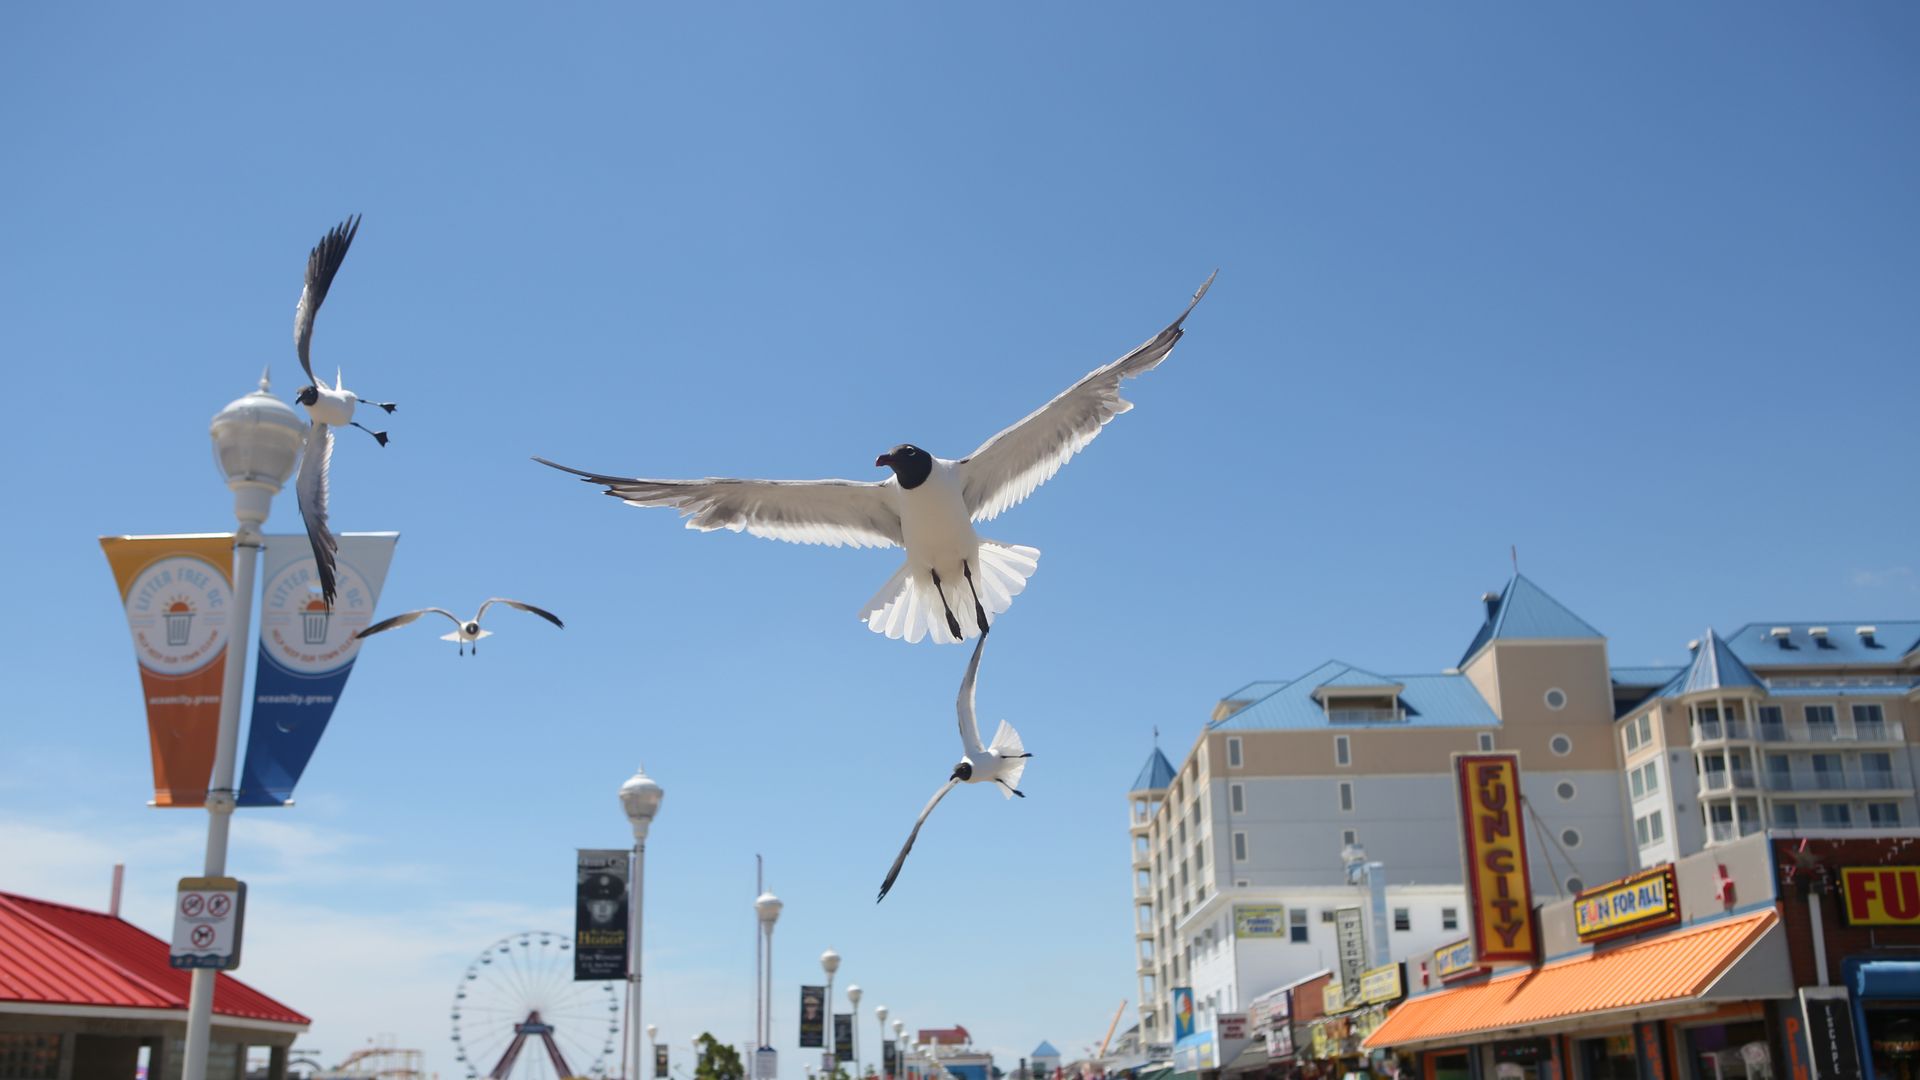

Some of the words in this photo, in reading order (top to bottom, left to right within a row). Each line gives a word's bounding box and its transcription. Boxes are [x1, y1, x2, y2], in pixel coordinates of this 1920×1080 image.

[136, 570, 171, 611] LITTER
[177, 568, 209, 589] FREE
[270, 569, 309, 608] LITTER
[150, 694, 220, 706] oceancity.green
[257, 693, 332, 706] oceancity.green
[1478, 765, 1511, 844] FUN
[1485, 848, 1525, 948] CITY
[1580, 898, 1610, 927] FUN
[1613, 890, 1636, 918] FOR
[1639, 880, 1663, 908] ALL!
[1847, 871, 1920, 920] FU
[578, 930, 624, 944] Honor
[1825, 1005, 1841, 1075] ESCAPE
